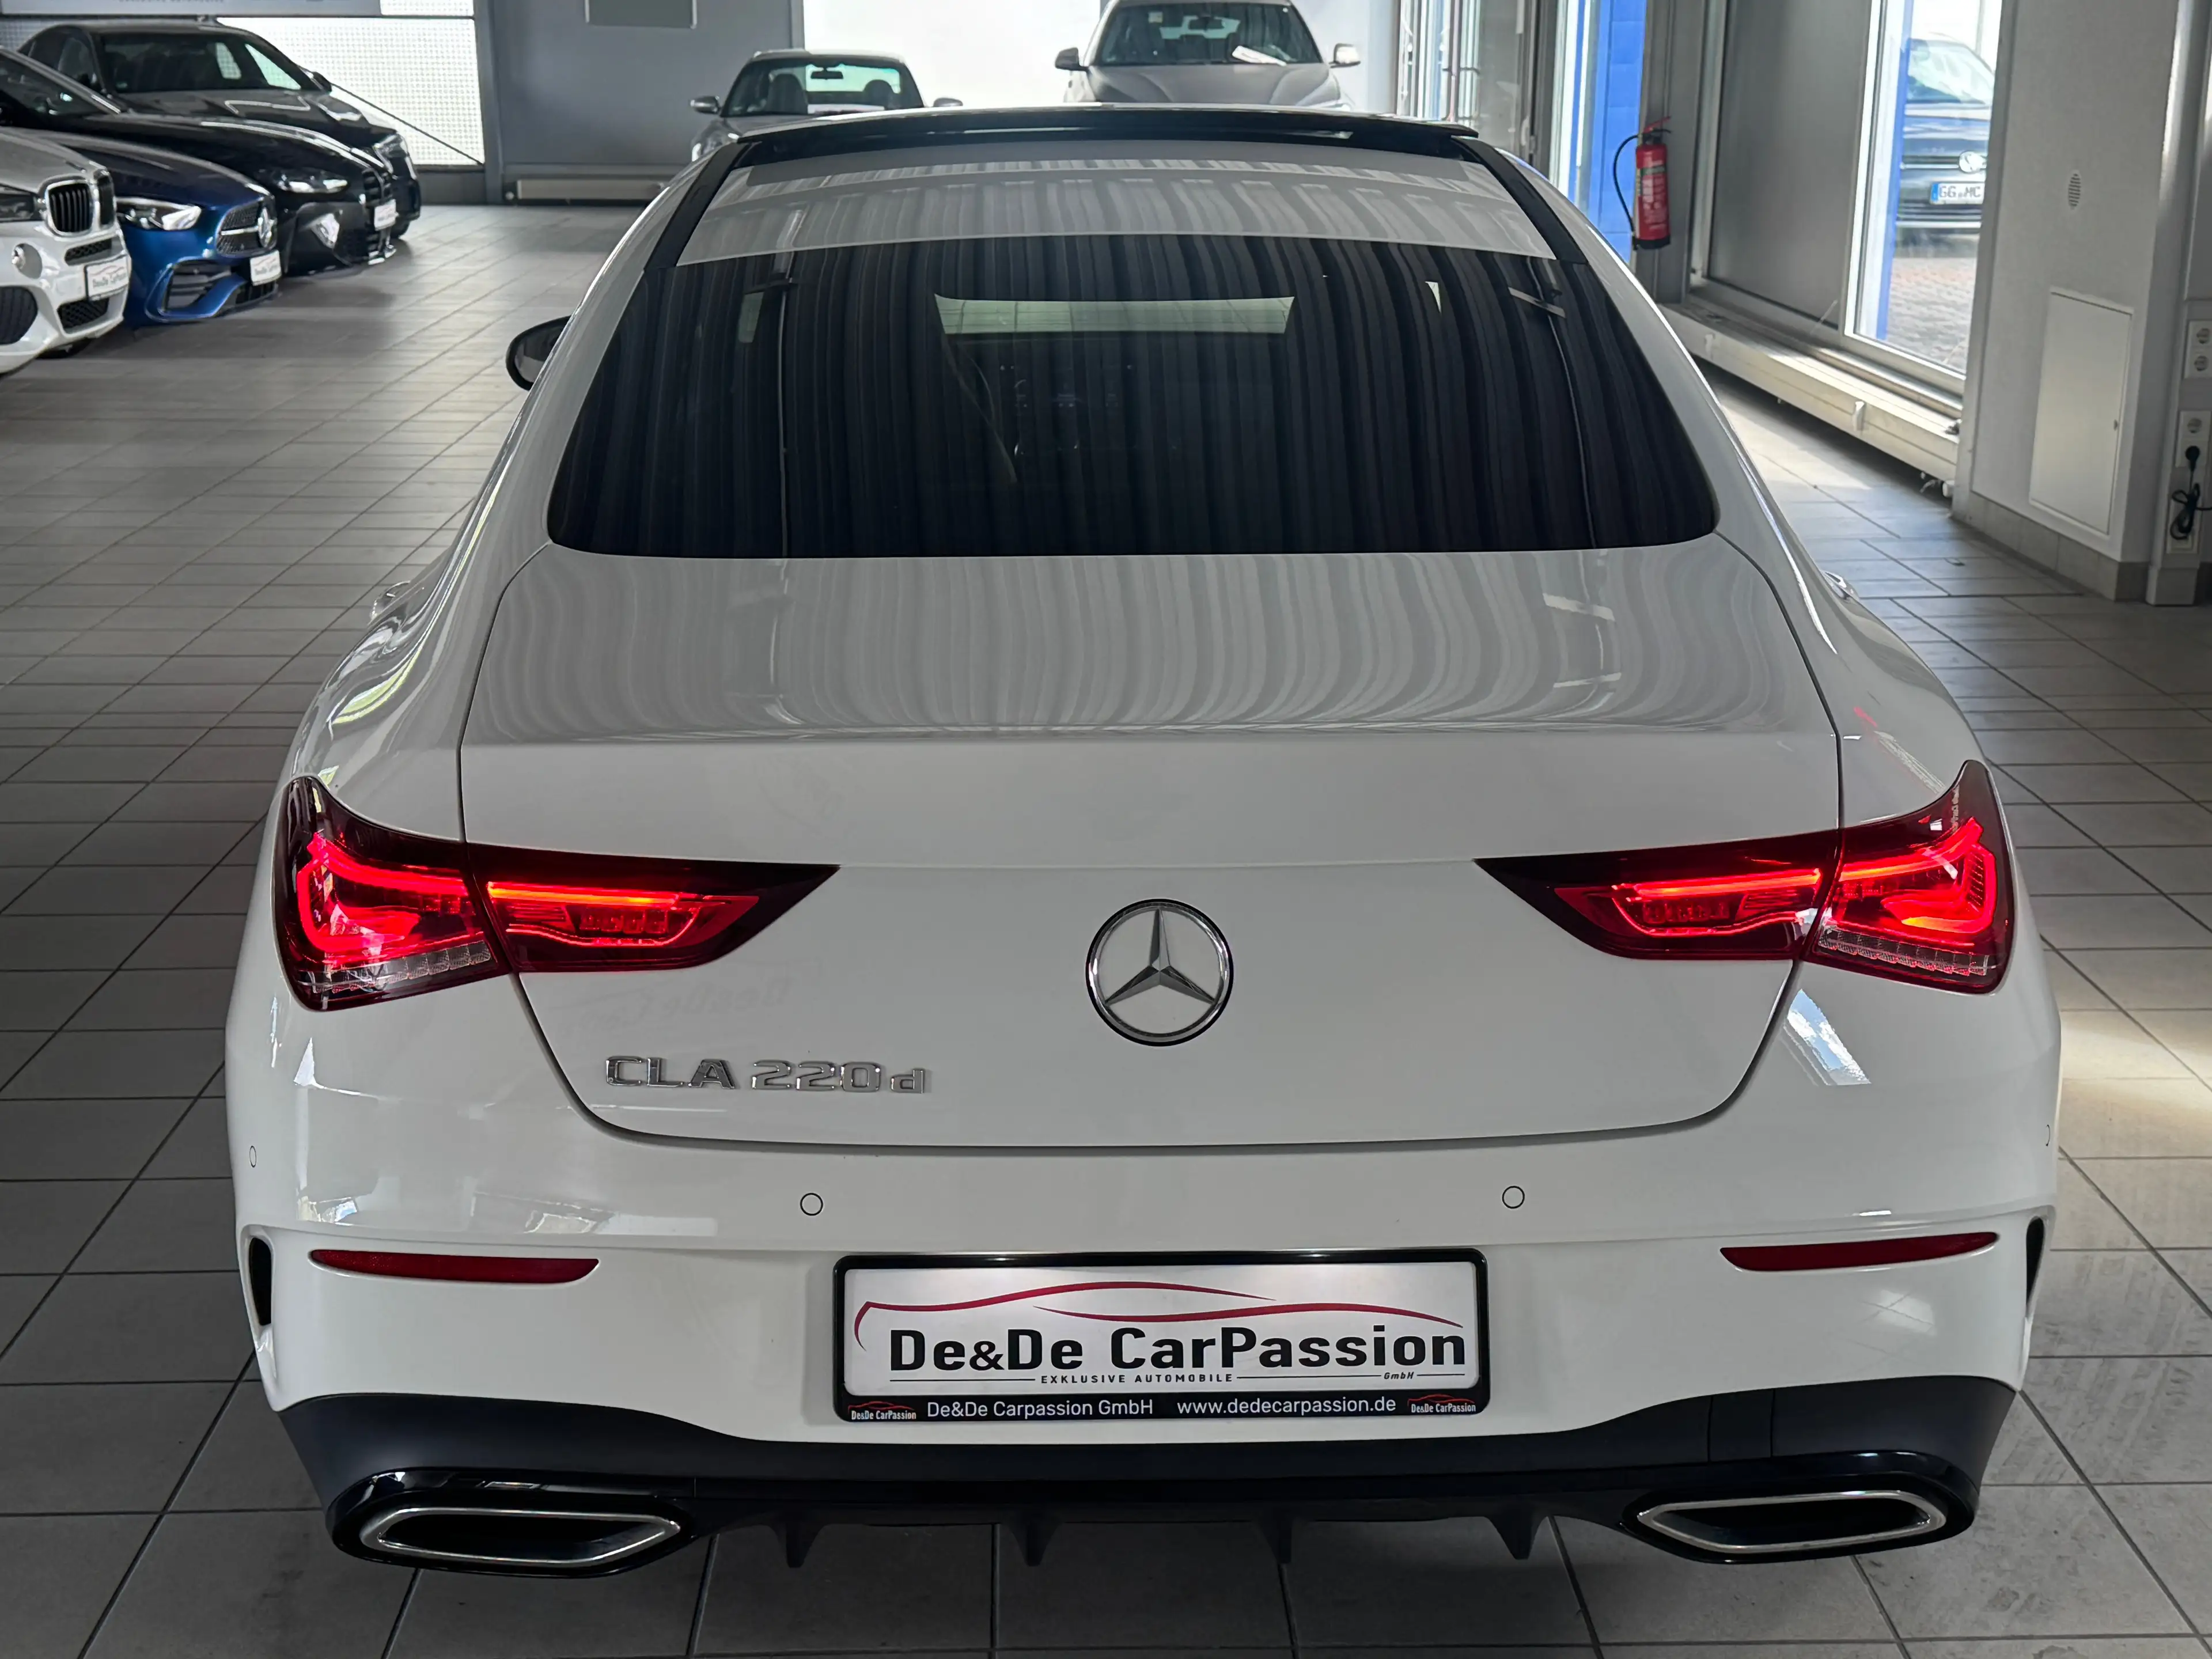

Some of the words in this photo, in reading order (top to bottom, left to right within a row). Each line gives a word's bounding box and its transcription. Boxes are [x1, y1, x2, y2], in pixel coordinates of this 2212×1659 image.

[605, 1055, 736, 1089] CLA
[891, 1329, 1083, 1371] De&De
[1111, 1325, 1465, 1369] CarPassion
[1040, 1374, 1126, 1384] EXKLUSIVE
[1134, 1373, 1233, 1383] AUTOMOBILE
[1384, 1372, 1414, 1380] GmbH
[927, 1401, 988, 1417] De&De
[993, 1400, 1093, 1419] Carpassion
[1098, 1399, 1153, 1415] GmbH
[1177, 1396, 1396, 1416] www.dedecarpassion.de
[1435, 1402, 1476, 1412] CarPassion
[876, 1410, 916, 1420] CarPassion
